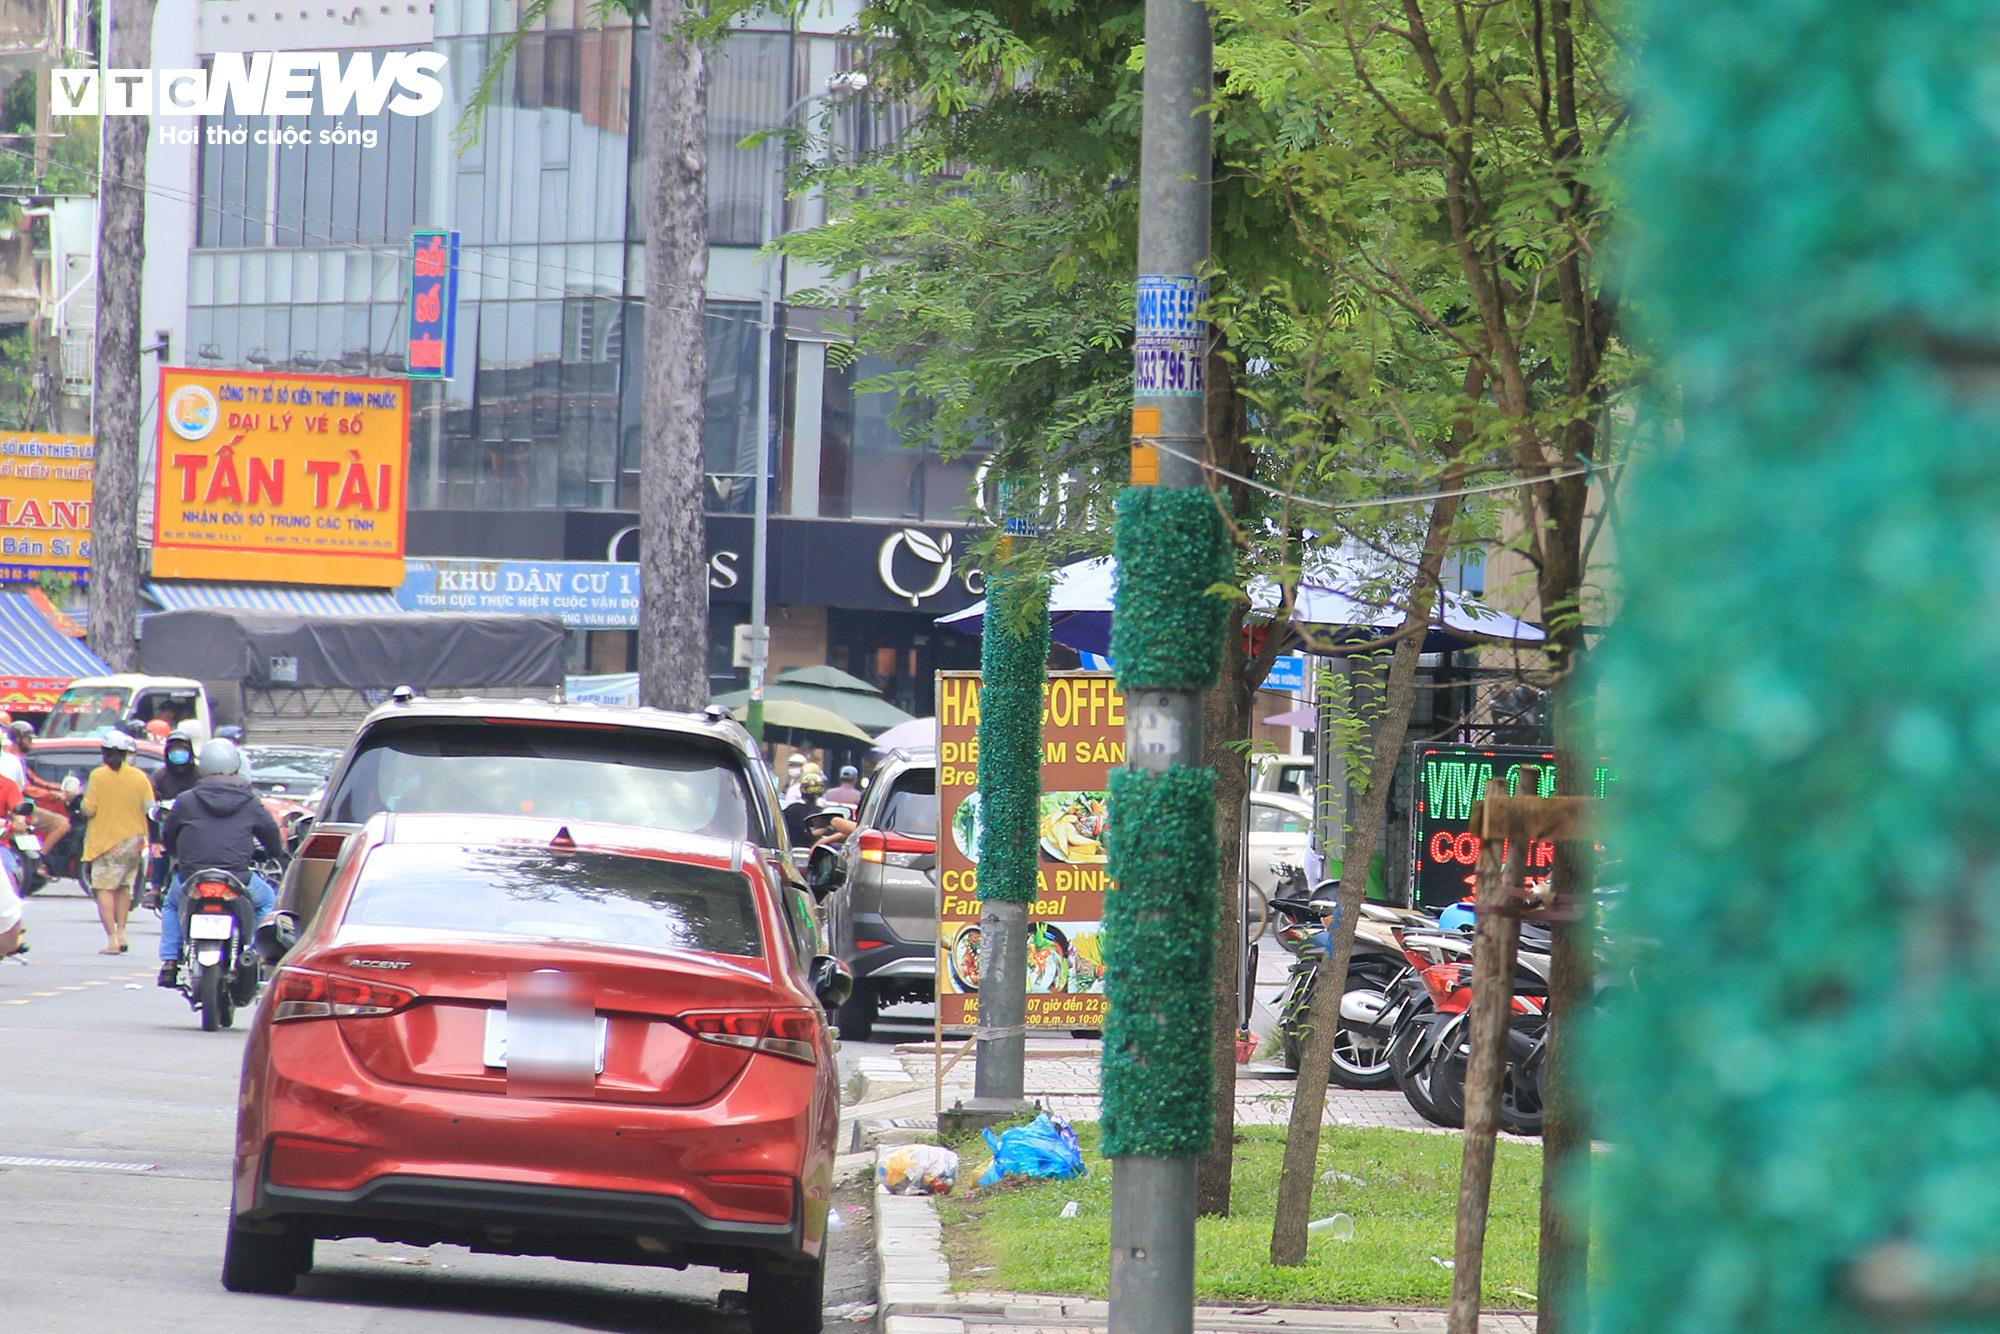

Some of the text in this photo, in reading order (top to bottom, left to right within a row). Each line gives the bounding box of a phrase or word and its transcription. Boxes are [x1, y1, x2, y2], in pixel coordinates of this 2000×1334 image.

[247, 387, 259, 401] TY
[227, 411, 365, 435] ĐẠI LÝ VÉ SỐ
[172, 435, 392, 511] TẤN TÀI
[182, 510, 218, 527] NHẬN
[317, 515, 341, 530] CÁC
[440, 570, 497, 592] KHU
[507, 567, 563, 592] DÂN
[572, 571, 610, 594] CƯ
[417, 592, 446, 606] TÍCH
[450, 594, 476, 608] CỰC
[480, 594, 514, 608] THỰC
[520, 594, 549, 609] HIỆN
[553, 596, 588, 610] CUỘC
[1075, 736, 1125, 764] SÁN
[942, 868, 978, 893] CƠ
[1027, 896, 1067, 916] eal
[349, 959, 411, 970] ACCENT
[1027, 999, 1040, 1011] 07
[1043, 999, 1062, 1014] giờ
[1063, 996, 1083, 1011] đến
[1086, 999, 1099, 1011] 22
[1066, 1014, 1076, 1024] to
[1078, 1014, 1104, 1024] 10:00
